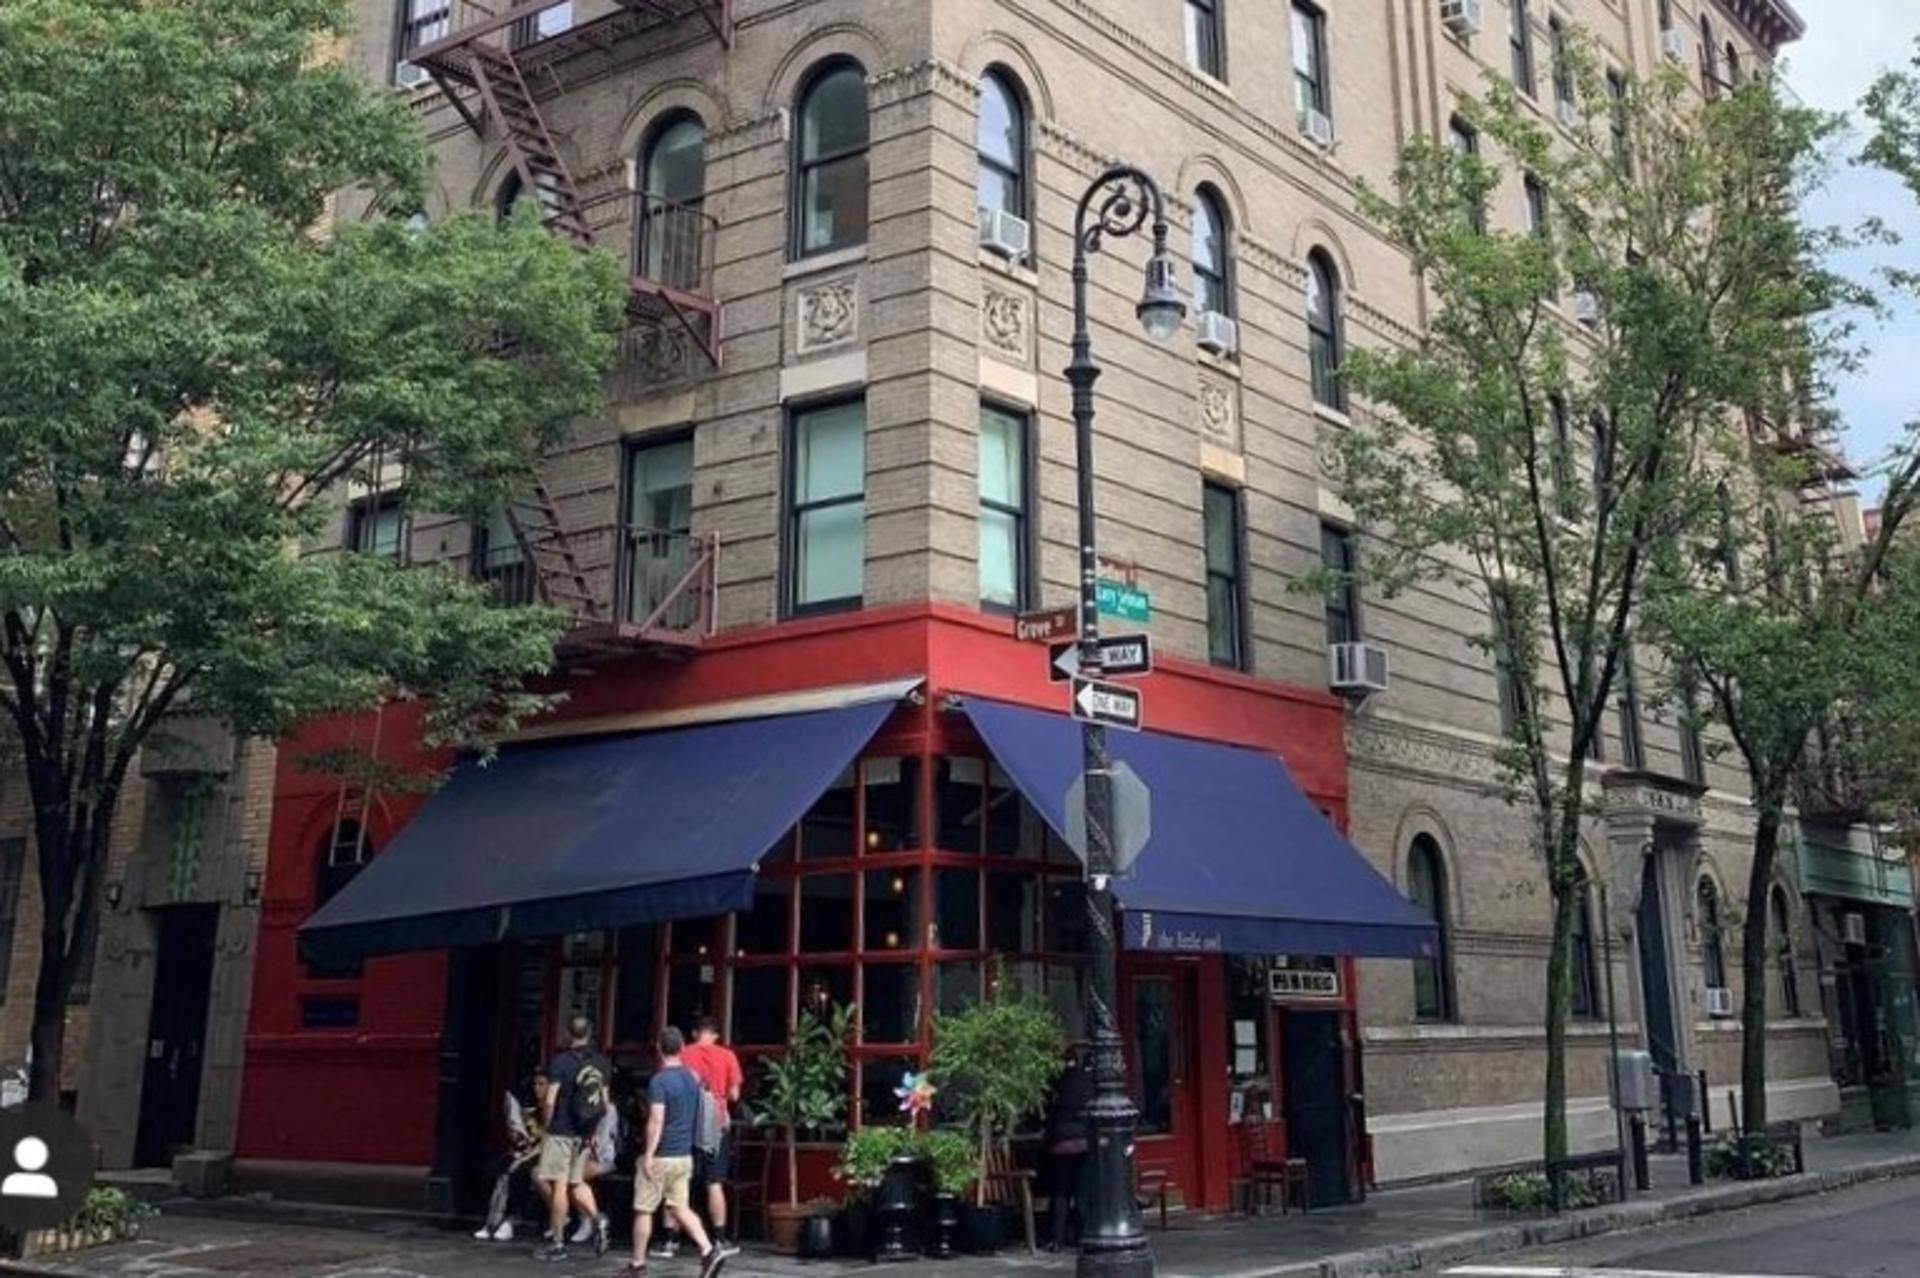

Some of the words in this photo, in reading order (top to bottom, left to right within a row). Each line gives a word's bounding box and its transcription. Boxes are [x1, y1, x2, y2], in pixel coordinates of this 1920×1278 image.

[1017, 619, 1051, 640] Grove
[1108, 645, 1138, 663] WAY
[1093, 692, 1110, 709] ONE
[1113, 698, 1132, 713] WAY
